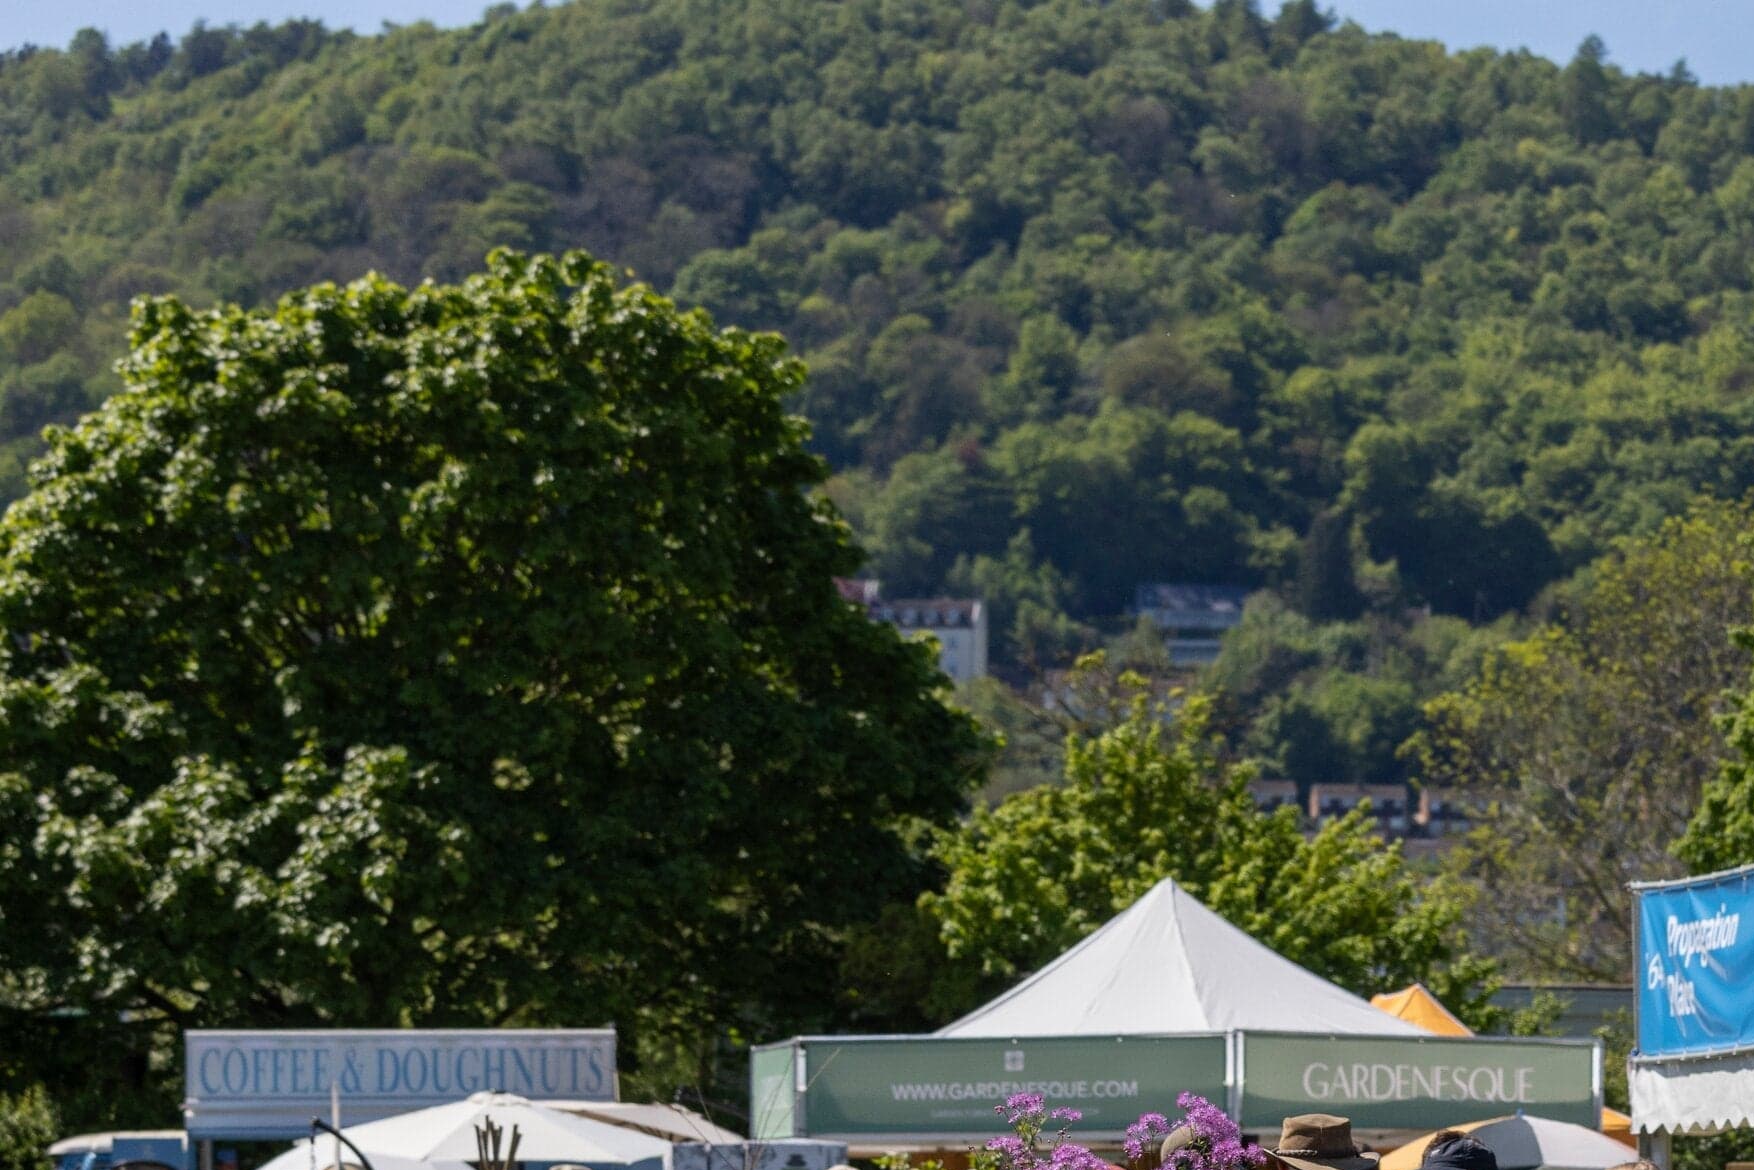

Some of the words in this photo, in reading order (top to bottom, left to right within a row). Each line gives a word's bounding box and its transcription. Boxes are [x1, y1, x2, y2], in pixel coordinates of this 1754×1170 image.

[1667, 902, 1740, 969] Propagation
[199, 1047, 332, 1095] COFFEE
[339, 1048, 362, 1094] &
[377, 1046, 605, 1094] DOUGHNUTS
[890, 1079, 1139, 1101] WWW.GARDENESQUE.COM
[1302, 1062, 1537, 1104] GARDENESQUE
